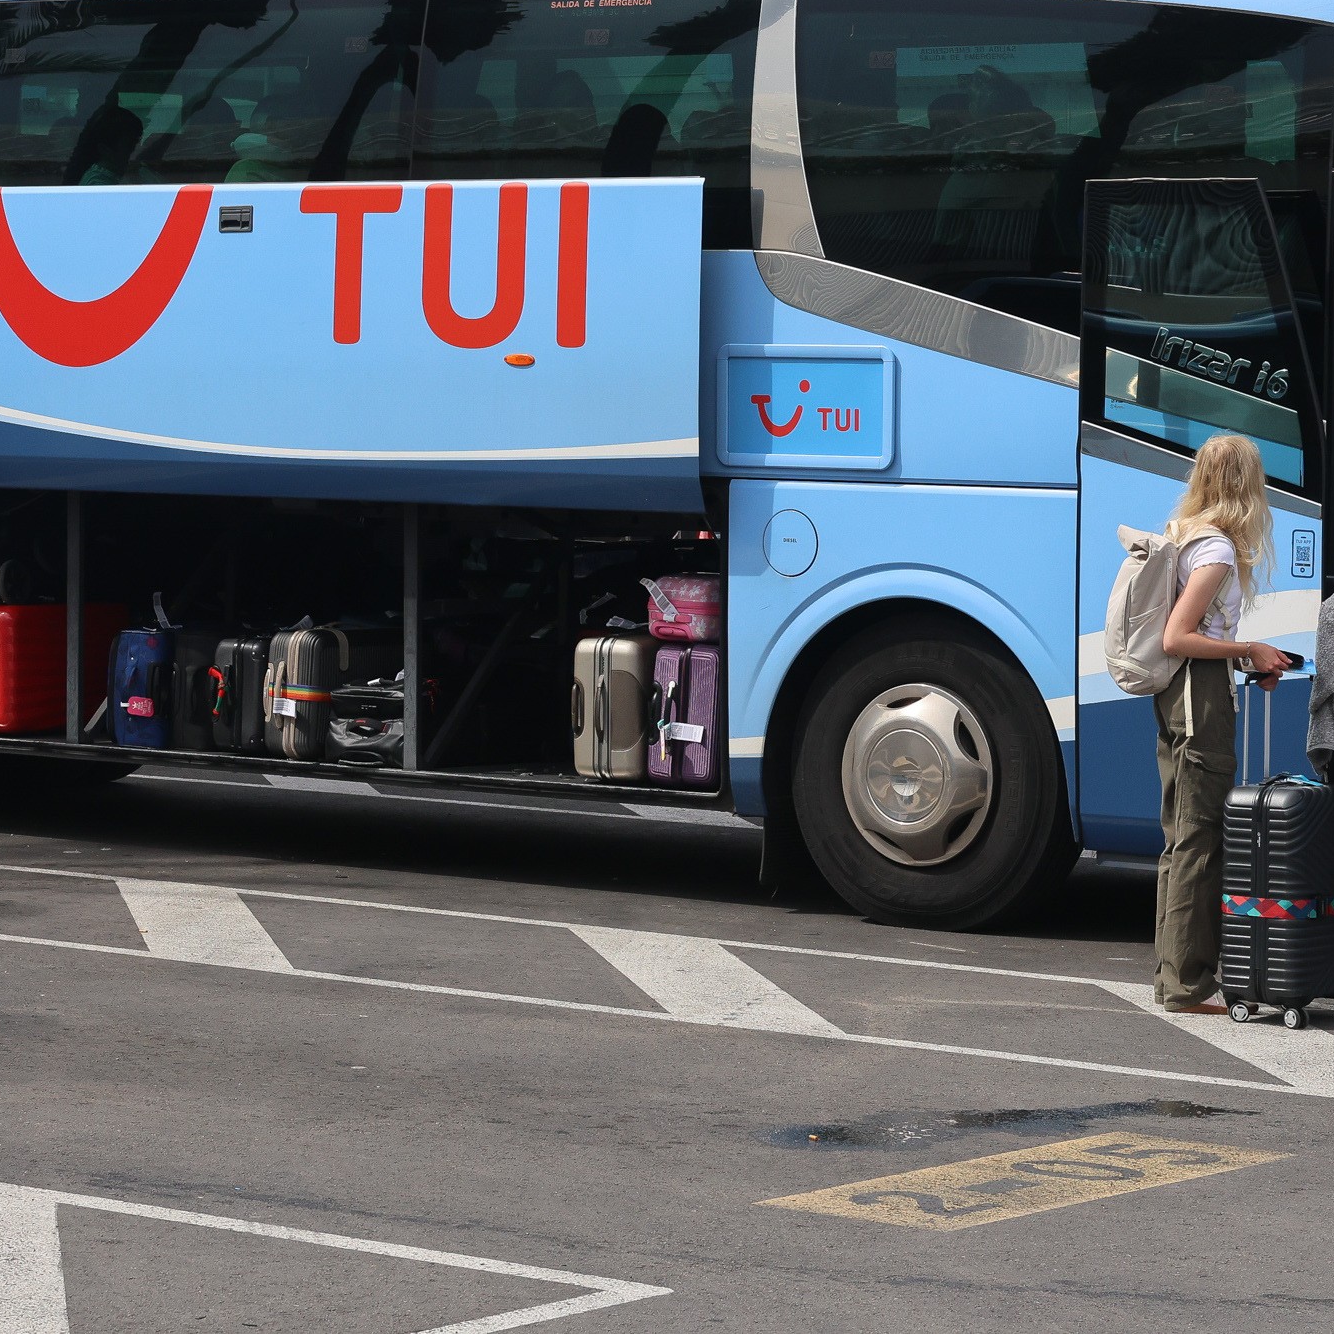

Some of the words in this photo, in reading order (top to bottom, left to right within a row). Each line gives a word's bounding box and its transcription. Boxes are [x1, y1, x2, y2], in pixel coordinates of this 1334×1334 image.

[550, 0, 579, 9] SALIDA
[583, 0, 595, 8] DE
[299, 181, 590, 349] TUI
[1150, 326, 1252, 385] Irizar
[1252, 360, 1289, 399] i6
[816, 407, 860, 432] TUI
[849, 1142, 1223, 1218] 2-05
